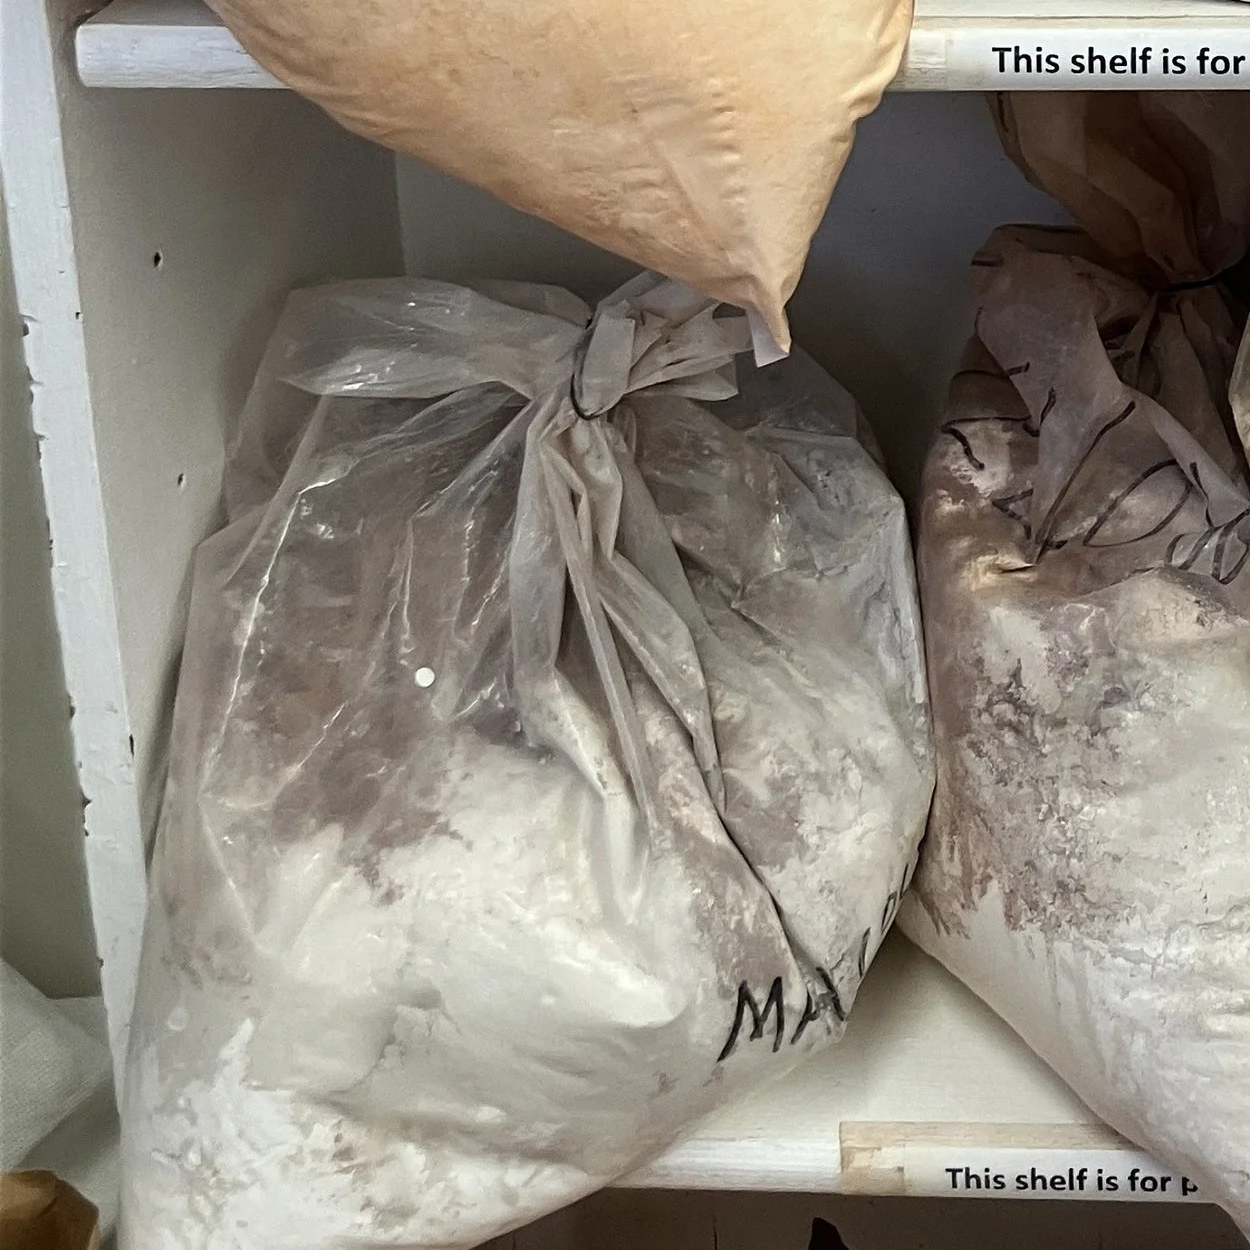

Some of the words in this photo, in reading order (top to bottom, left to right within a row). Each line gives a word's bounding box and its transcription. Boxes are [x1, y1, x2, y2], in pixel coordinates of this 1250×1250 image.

[991, 45, 1060, 74] This
[1070, 46, 1153, 74] shelf
[1162, 47, 1187, 75] is
[1196, 47, 1246, 75] for
[945, 1166, 1006, 1190] This
[1015, 1167, 1088, 1191] shelf
[1097, 1168, 1119, 1191] is
[1128, 1168, 1172, 1192] for
